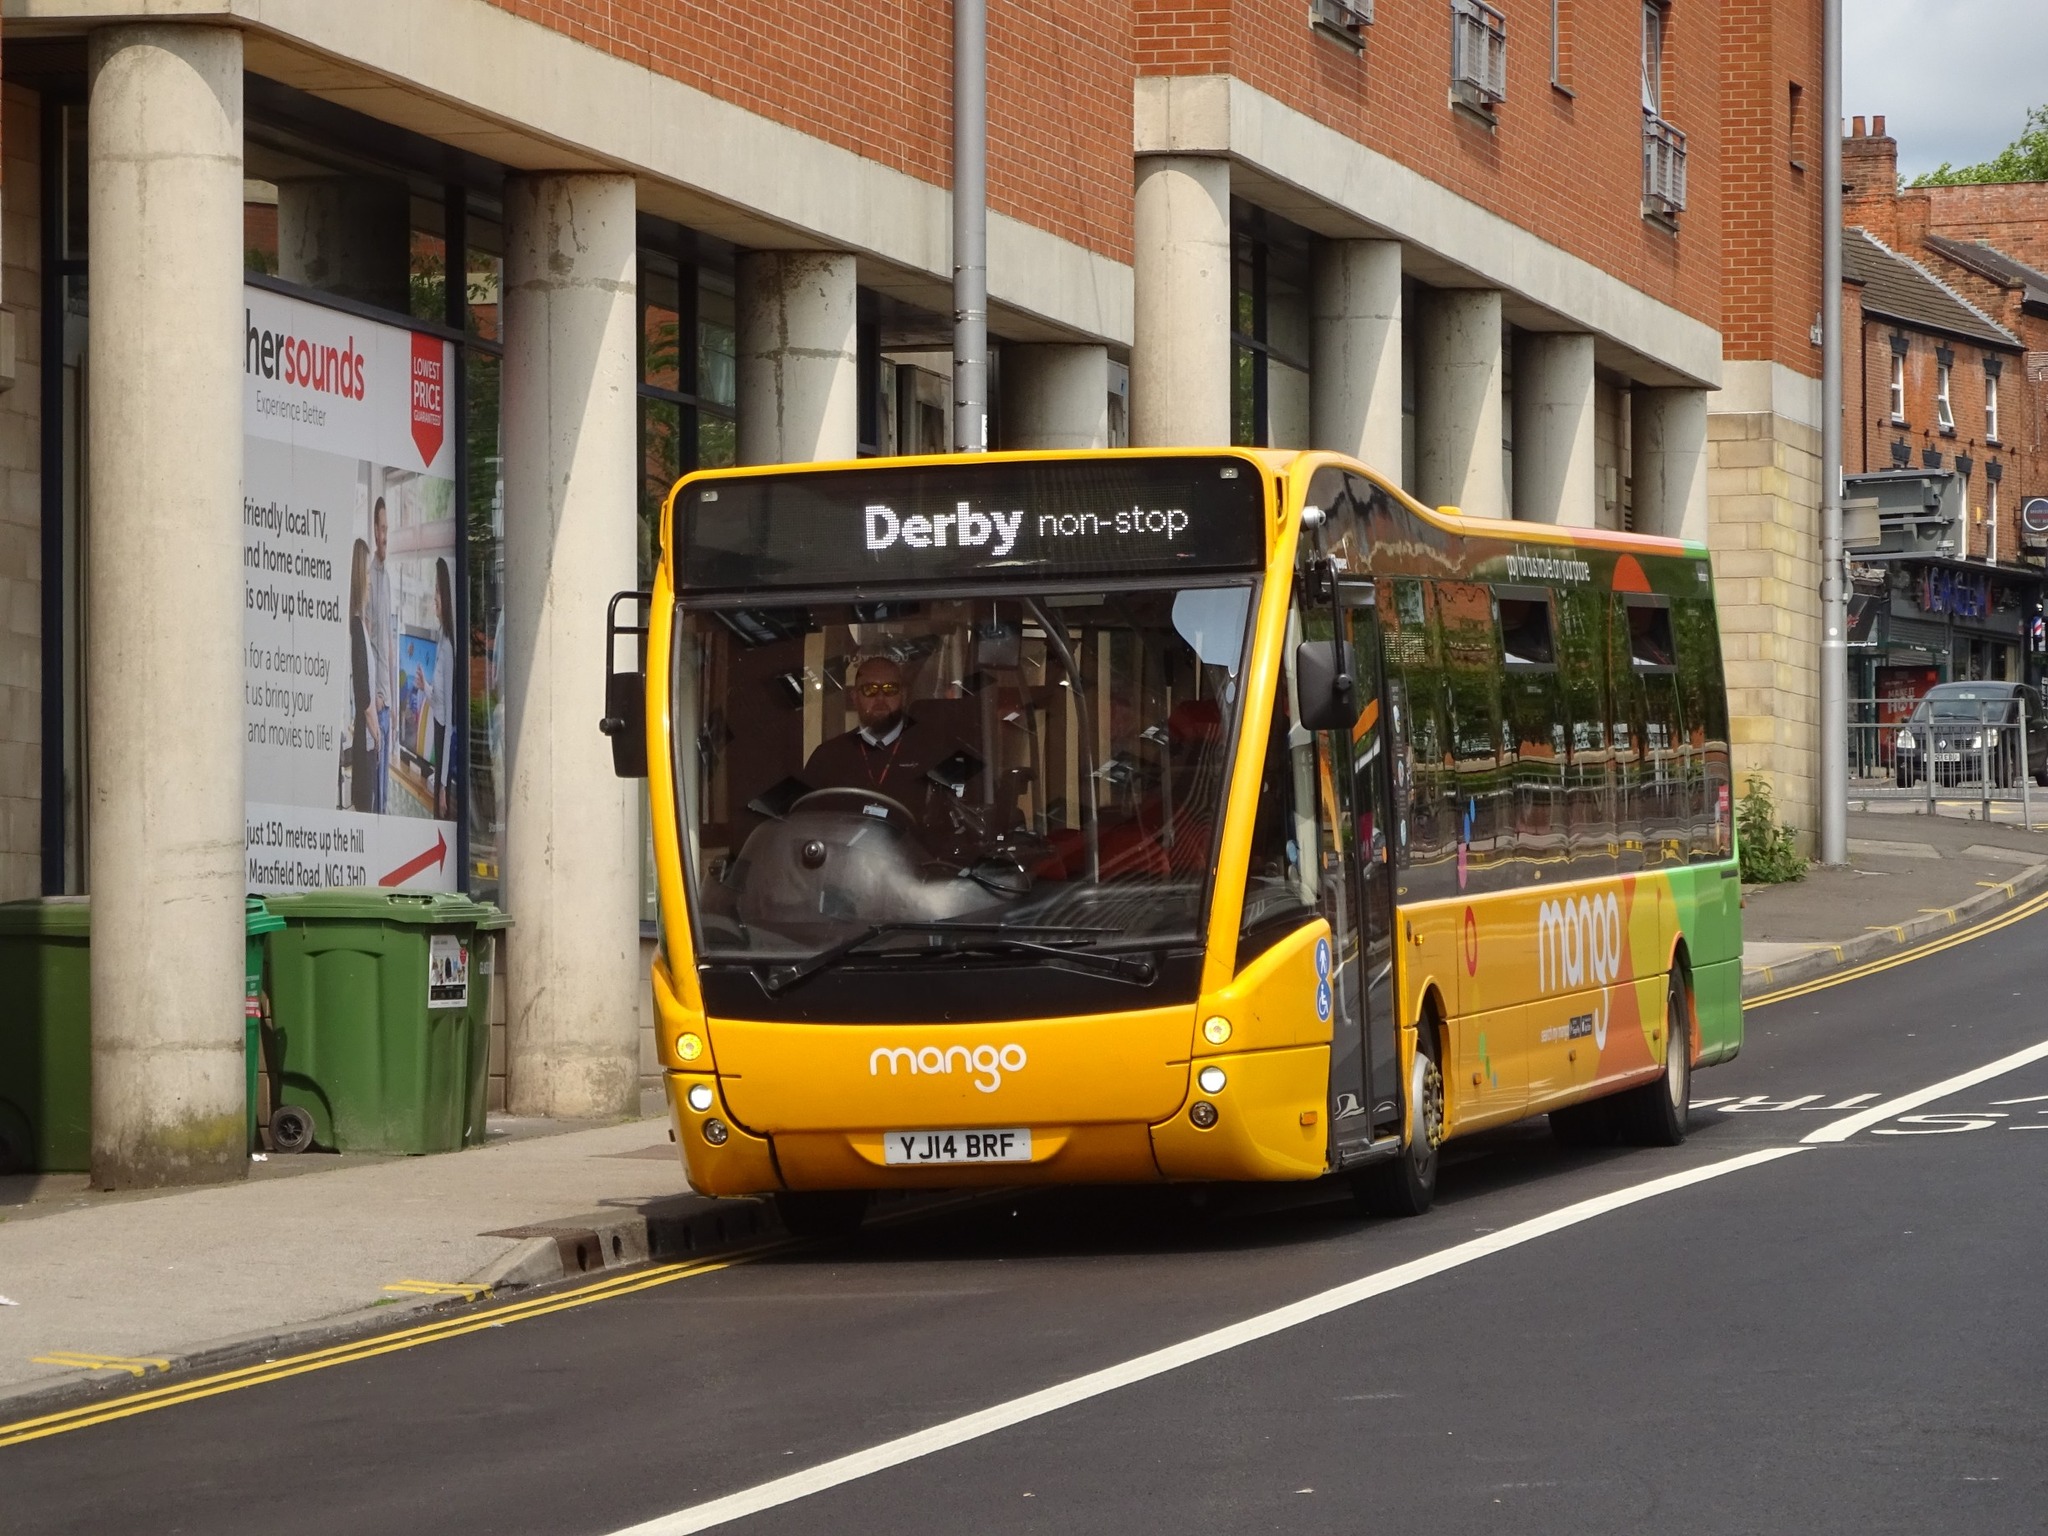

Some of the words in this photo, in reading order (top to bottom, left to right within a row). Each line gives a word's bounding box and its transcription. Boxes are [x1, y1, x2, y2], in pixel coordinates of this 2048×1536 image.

[245, 308, 365, 401] hersounds
[413, 356, 441, 380] LOWEST
[256, 390, 300, 421] Experience
[302, 400, 326, 426] Better
[413, 379, 441, 412] PRICE
[243, 496, 283, 539] friendly
[285, 504, 310, 536] local
[311, 509, 328, 544] TV,
[865, 502, 1024, 556] Derby
[1039, 505, 1189, 540] non-stop
[262, 541, 293, 574] home
[294, 548, 332, 581] cinema
[245, 580, 254, 609] is
[256, 584, 280, 621] only
[281, 593, 295, 623] up
[297, 589, 314, 619] the
[316, 594, 342, 623] road.
[249, 641, 264, 669] for
[265, 650, 272, 671] a
[273, 645, 302, 675] demo
[304, 651, 331, 686] today
[251, 685, 263, 707] us
[265, 680, 290, 717] bring
[291, 690, 314, 718] your
[247, 717, 266, 744] and
[268, 720, 302, 749] movies
[304, 724, 315, 750] to
[316, 724, 333, 752] life!
[245, 819, 264, 851] just
[266, 821, 284, 848] 150
[285, 826, 318, 851] metres
[319, 831, 332, 858] up
[333, 827, 349, 853] the
[350, 828, 365, 854] hill
[249, 858, 295, 886] Mansfield
[297, 861, 324, 889] Road,
[325, 863, 343, 888] NG1
[1539, 891, 1620, 1050] mango
[869, 1043, 1027, 1093] mango
[900, 1135, 958, 1160] YJ14
[965, 1133, 1015, 1158] BRF
